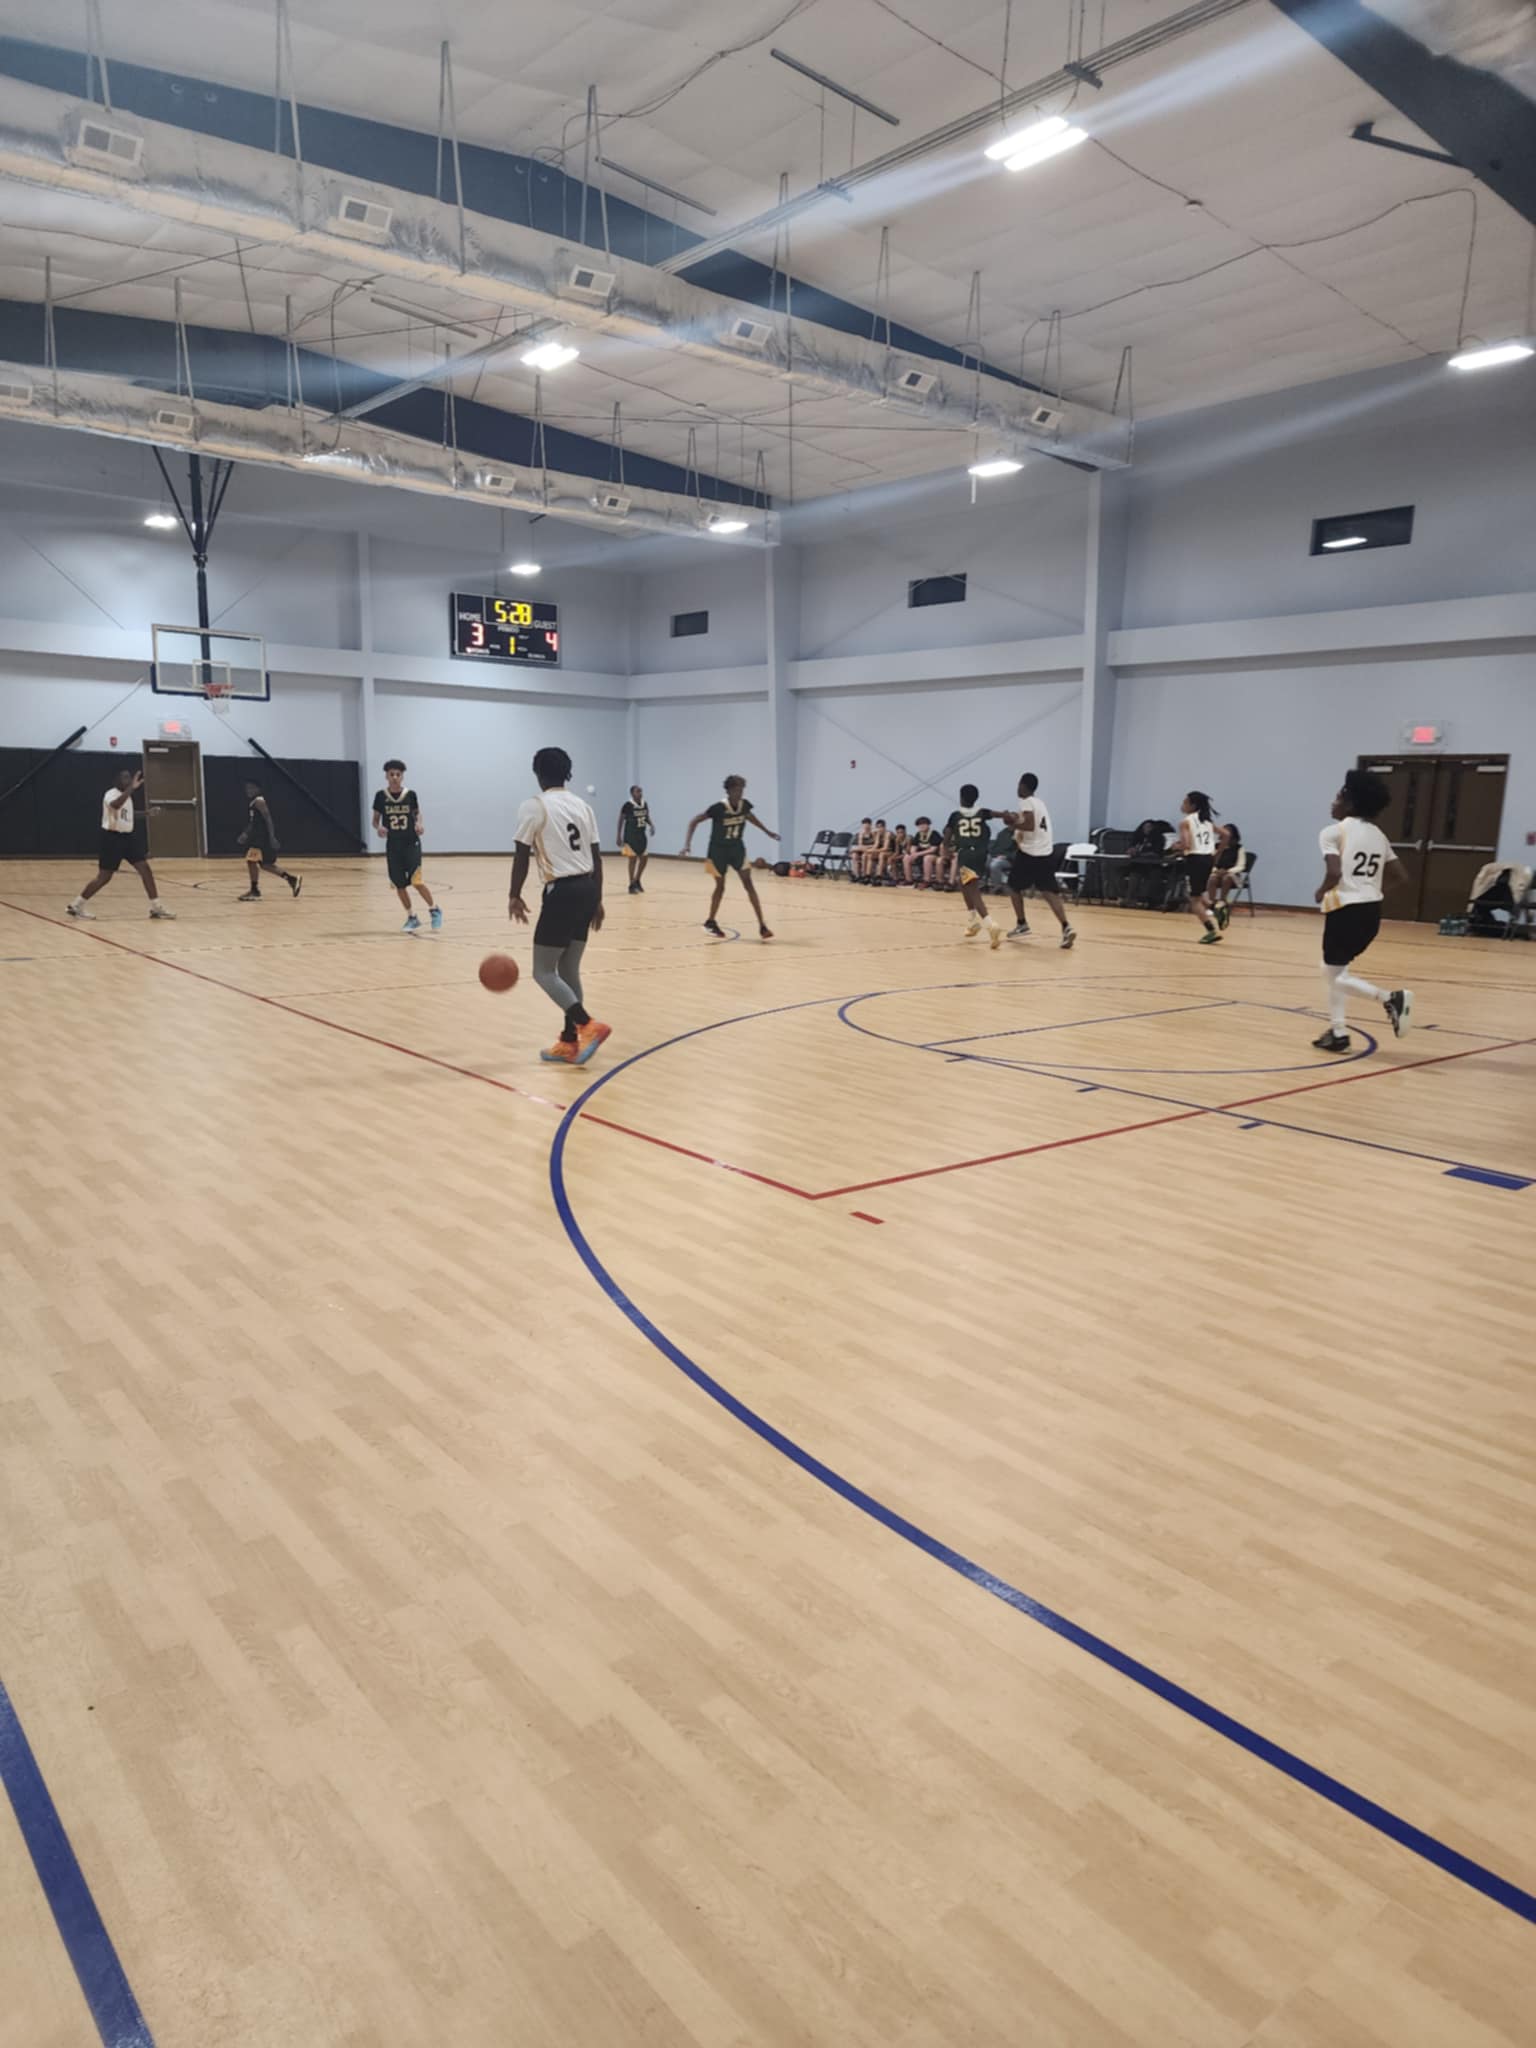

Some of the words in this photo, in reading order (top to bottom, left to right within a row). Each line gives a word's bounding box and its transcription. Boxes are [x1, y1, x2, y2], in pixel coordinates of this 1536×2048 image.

[459, 612, 481, 621] HOME
[534, 619, 557, 630] GUEST
[472, 622, 484, 647] 3
[545, 631, 558, 652] 4
[509, 636, 516, 655] 1
[389, 814, 408, 830] 23
[958, 817, 982, 838] 25
[1039, 816, 1047, 832] 4
[566, 822, 581, 852] 2
[1195, 831, 1211, 846] 12
[1352, 851, 1381, 878] 25
